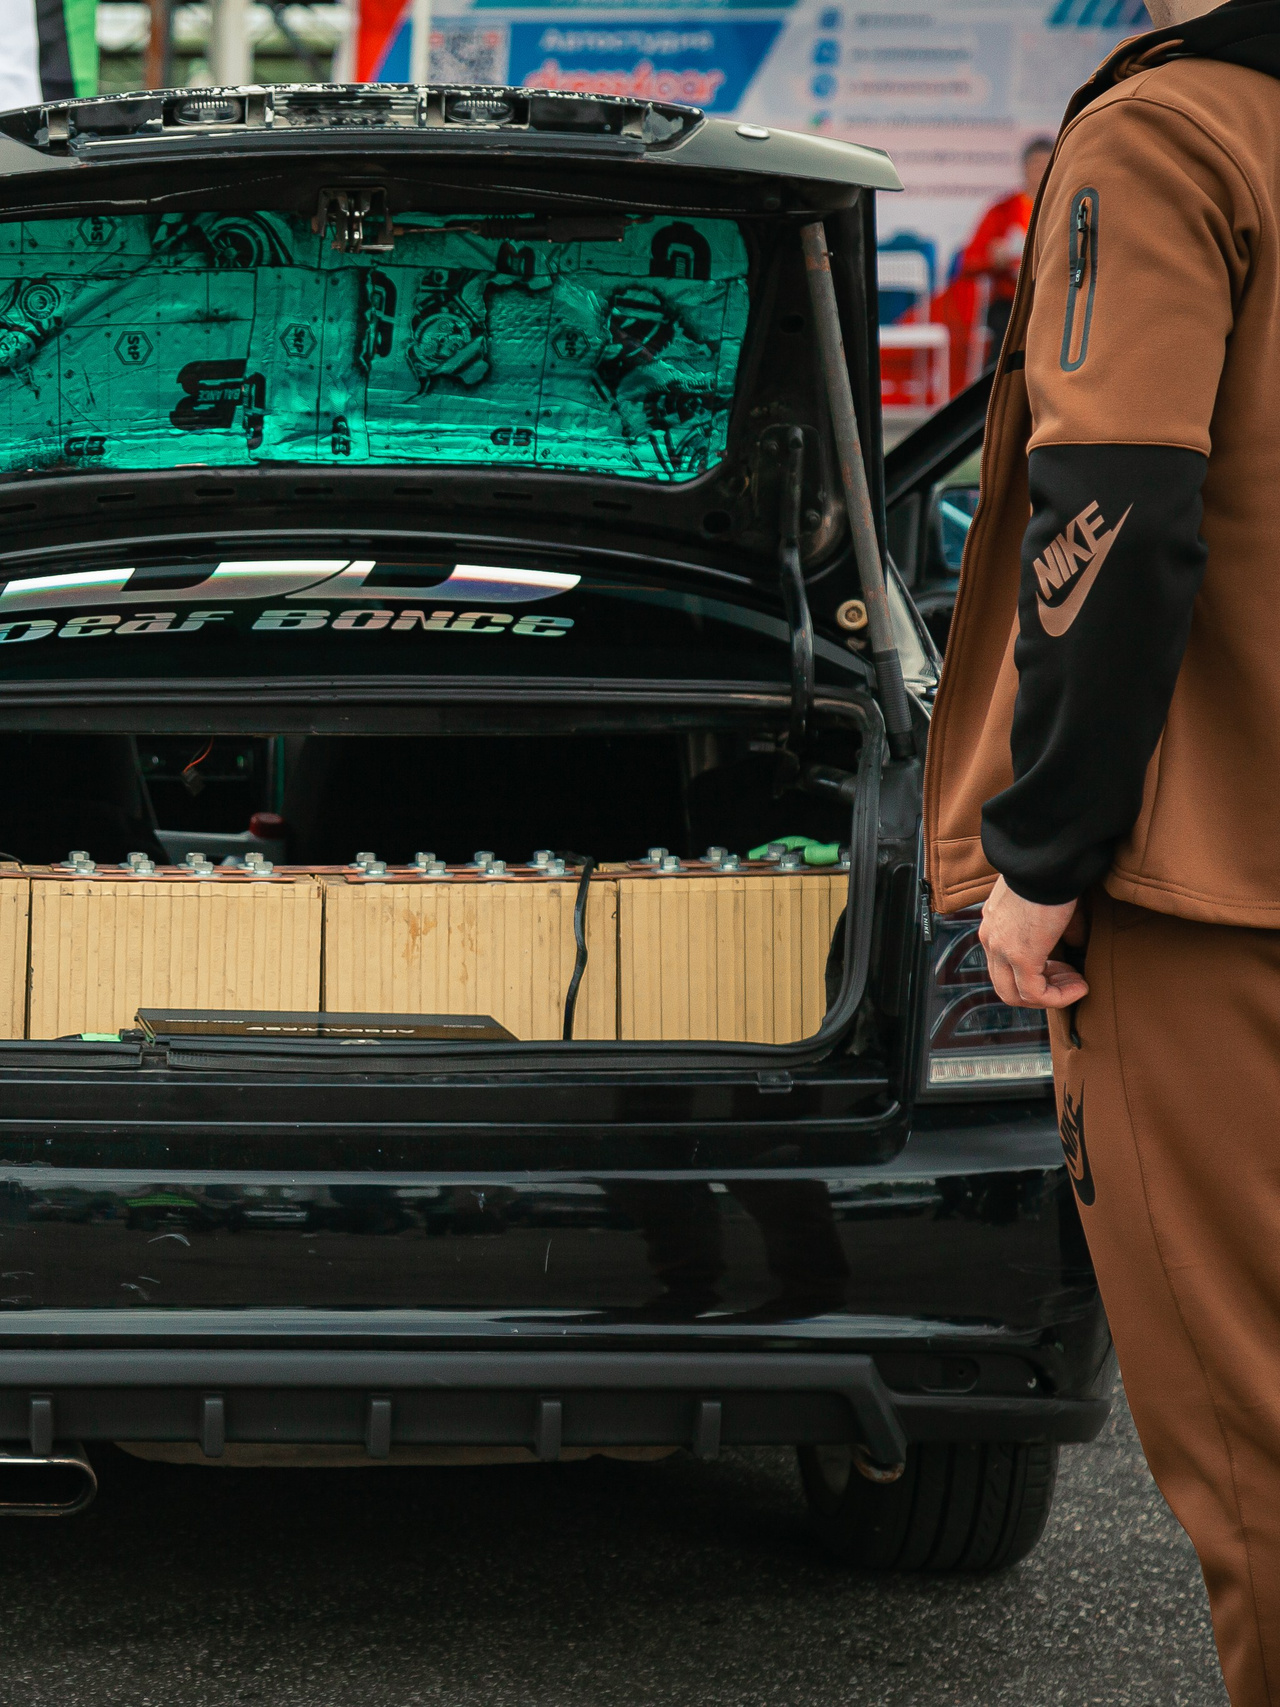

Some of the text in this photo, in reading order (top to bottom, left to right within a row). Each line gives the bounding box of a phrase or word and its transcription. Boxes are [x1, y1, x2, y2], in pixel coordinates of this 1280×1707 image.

[127, 336, 140, 360] StP
[64, 436, 107, 456] GB
[490, 427, 532, 446] GB
[1033, 500, 1114, 600] NIKE
